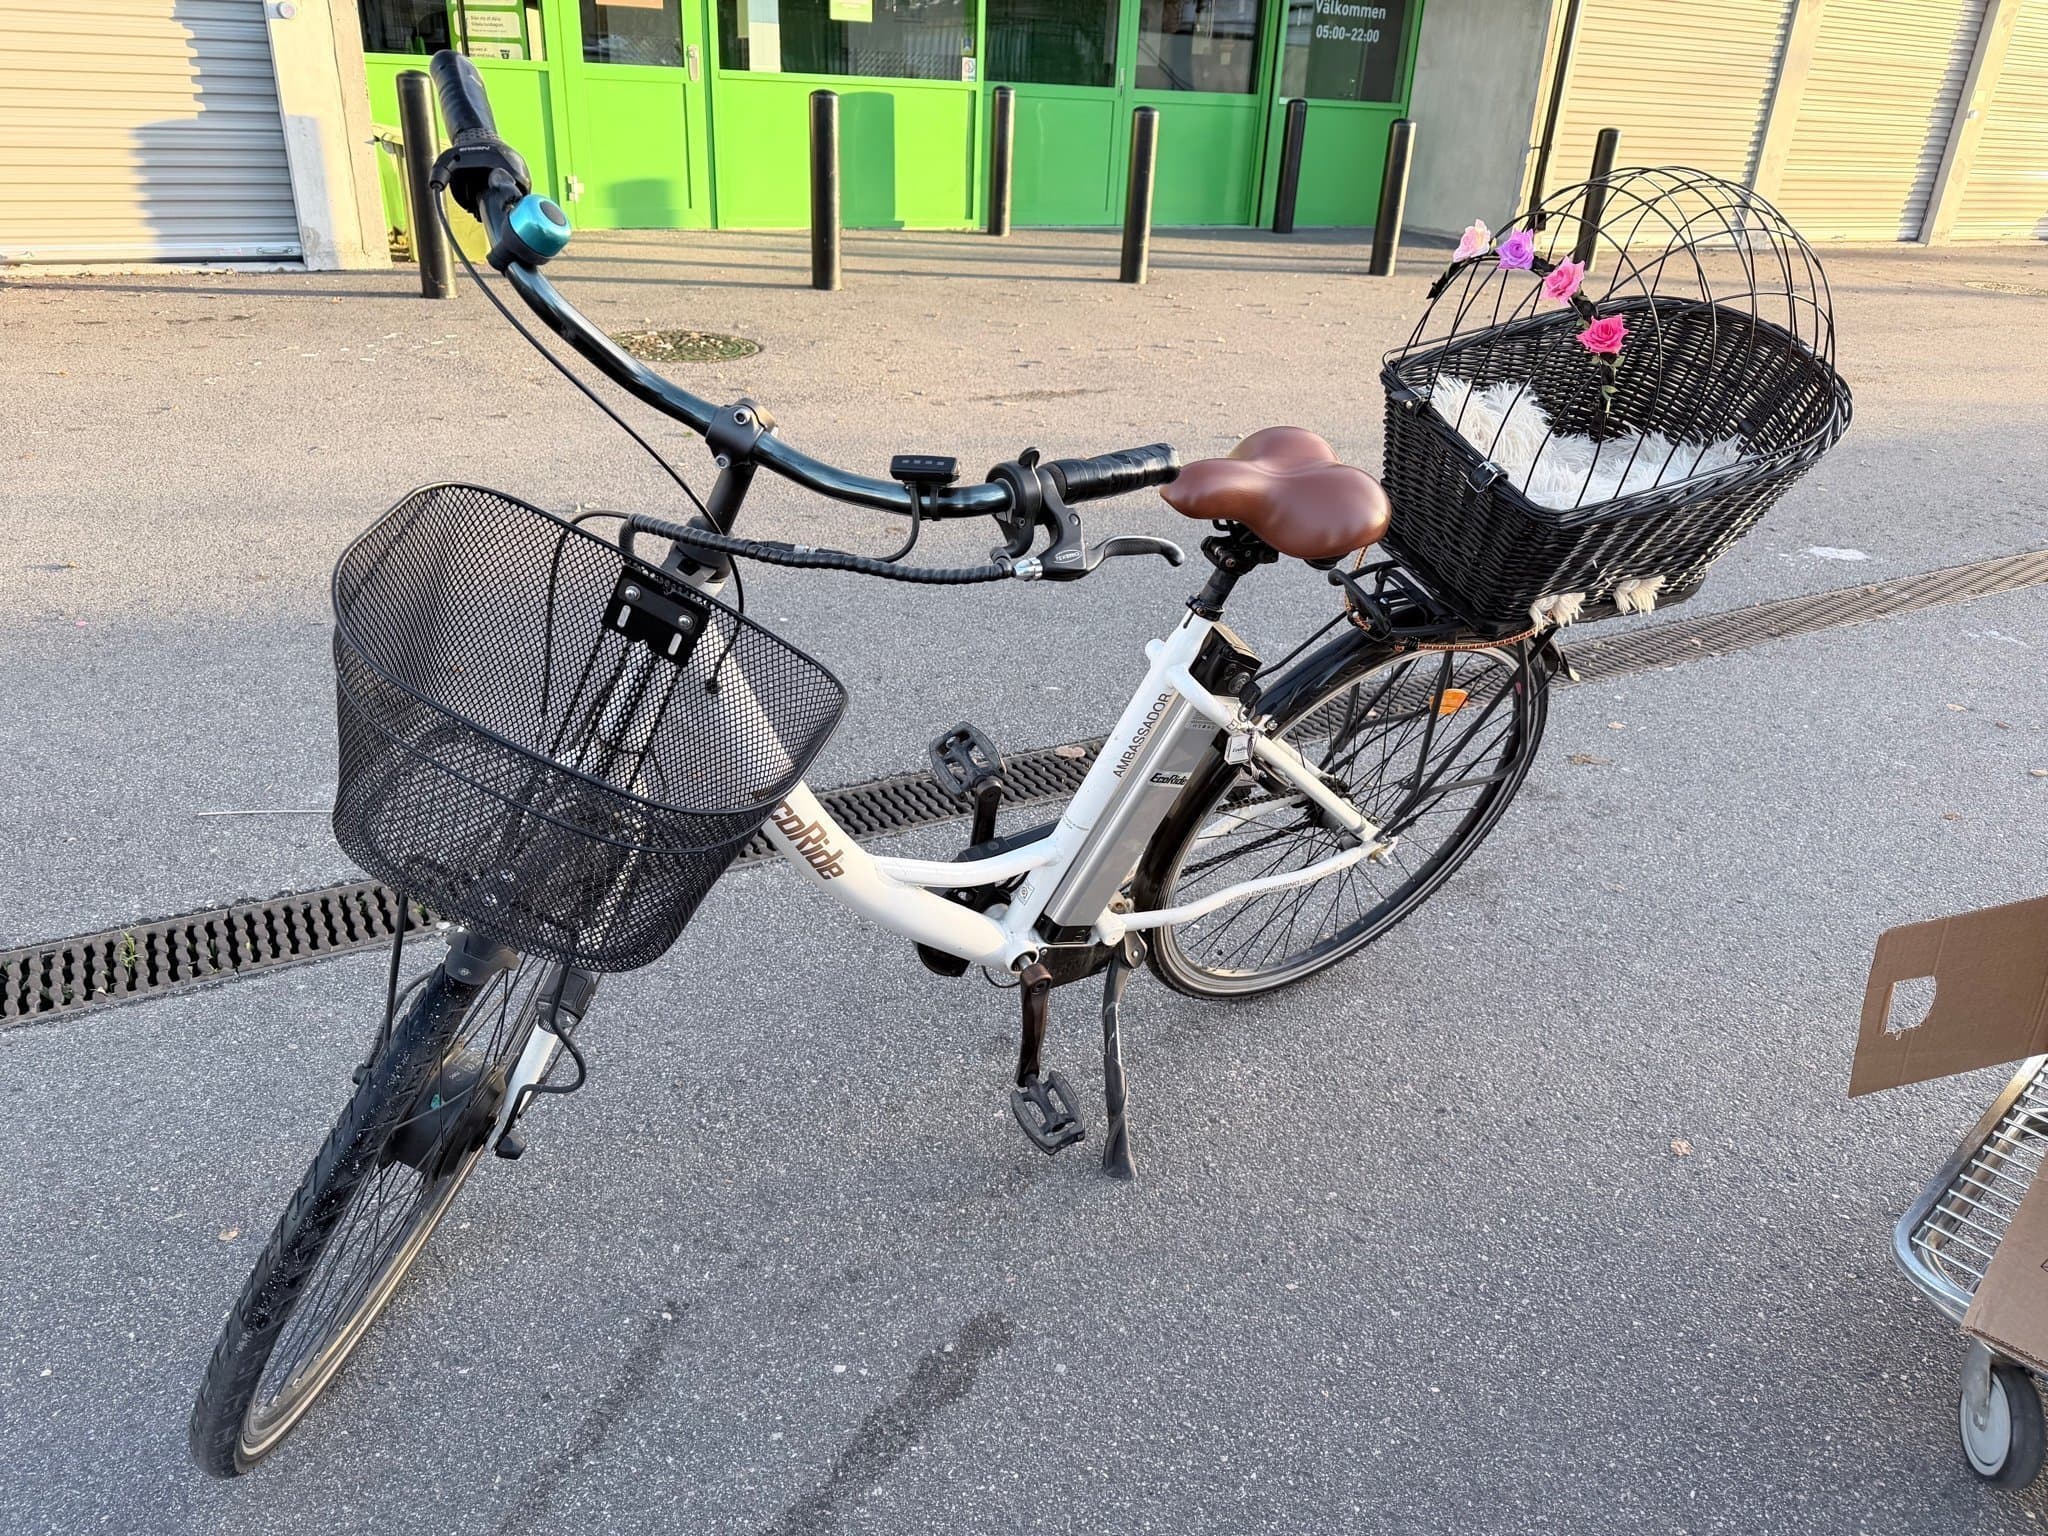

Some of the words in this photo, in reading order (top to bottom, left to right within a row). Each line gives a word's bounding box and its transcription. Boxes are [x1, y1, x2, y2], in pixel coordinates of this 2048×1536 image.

[1316, 0, 1386, 19] Välkommen
[1113, 693, 1172, 778] AMBASSADOR
[770, 799, 845, 880] coRide
